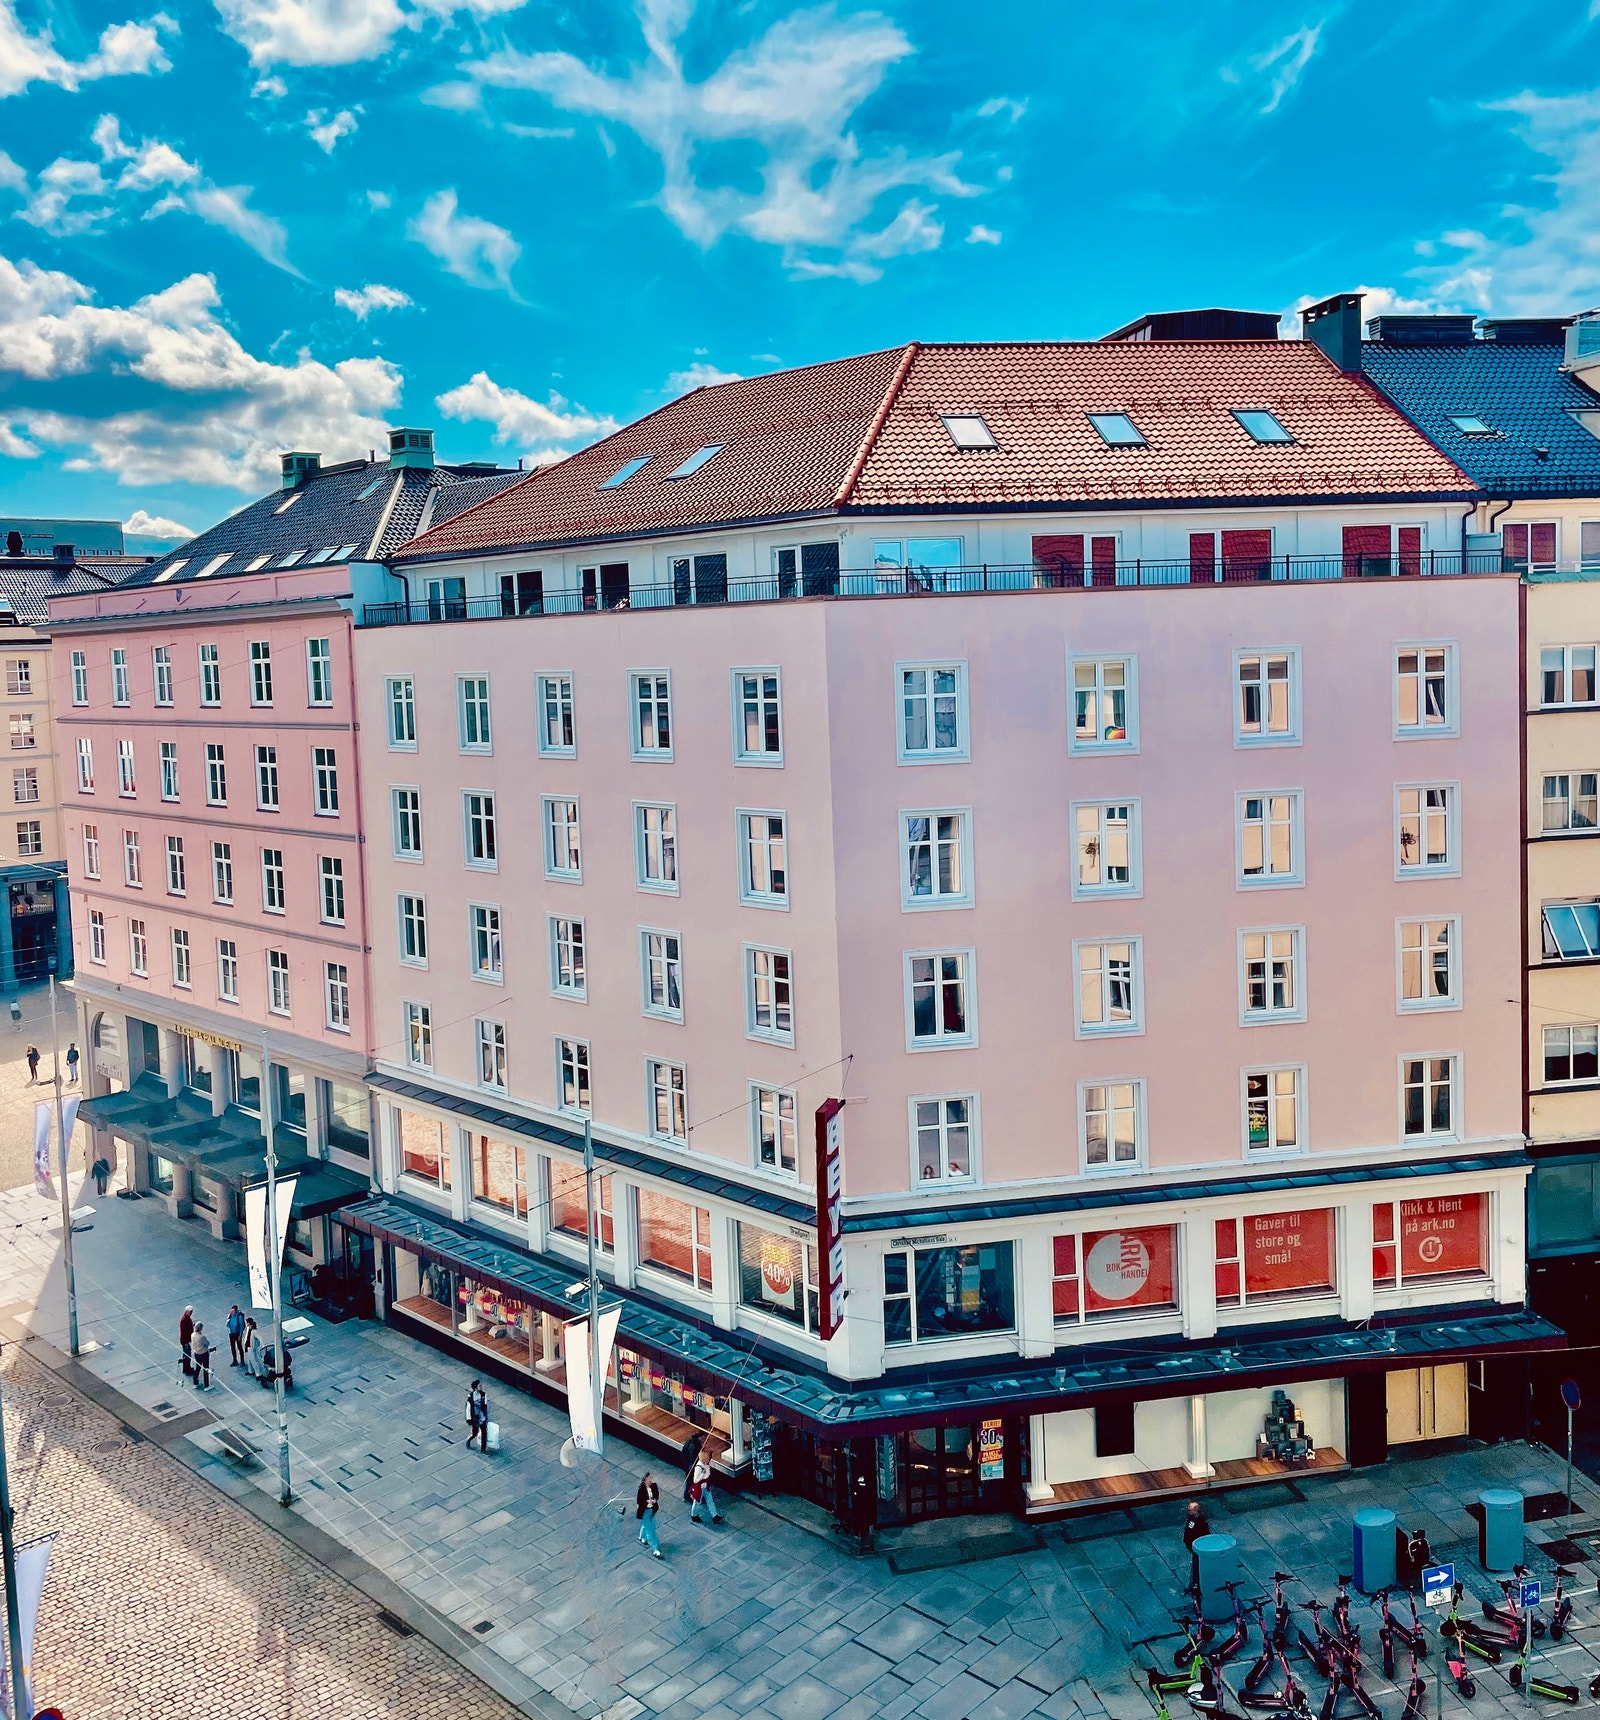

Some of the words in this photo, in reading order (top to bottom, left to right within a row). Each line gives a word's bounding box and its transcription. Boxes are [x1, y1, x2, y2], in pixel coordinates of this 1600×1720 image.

[1427, 1200, 1435, 1213] &
[1438, 1199, 1463, 1212] Hent
[826, 1114, 844, 1328] BEYER
[1255, 1218, 1286, 1231] Gaver
[1289, 1214, 1301, 1228] til
[1405, 1219, 1418, 1236] på
[1421, 1218, 1455, 1232] ark.no
[1255, 1236, 1284, 1249] store
[1287, 1234, 1301, 1247] og
[1120, 1233, 1141, 1270] ARK
[1265, 1249, 1292, 1265] små!
[1106, 1263, 1121, 1273] BOK
